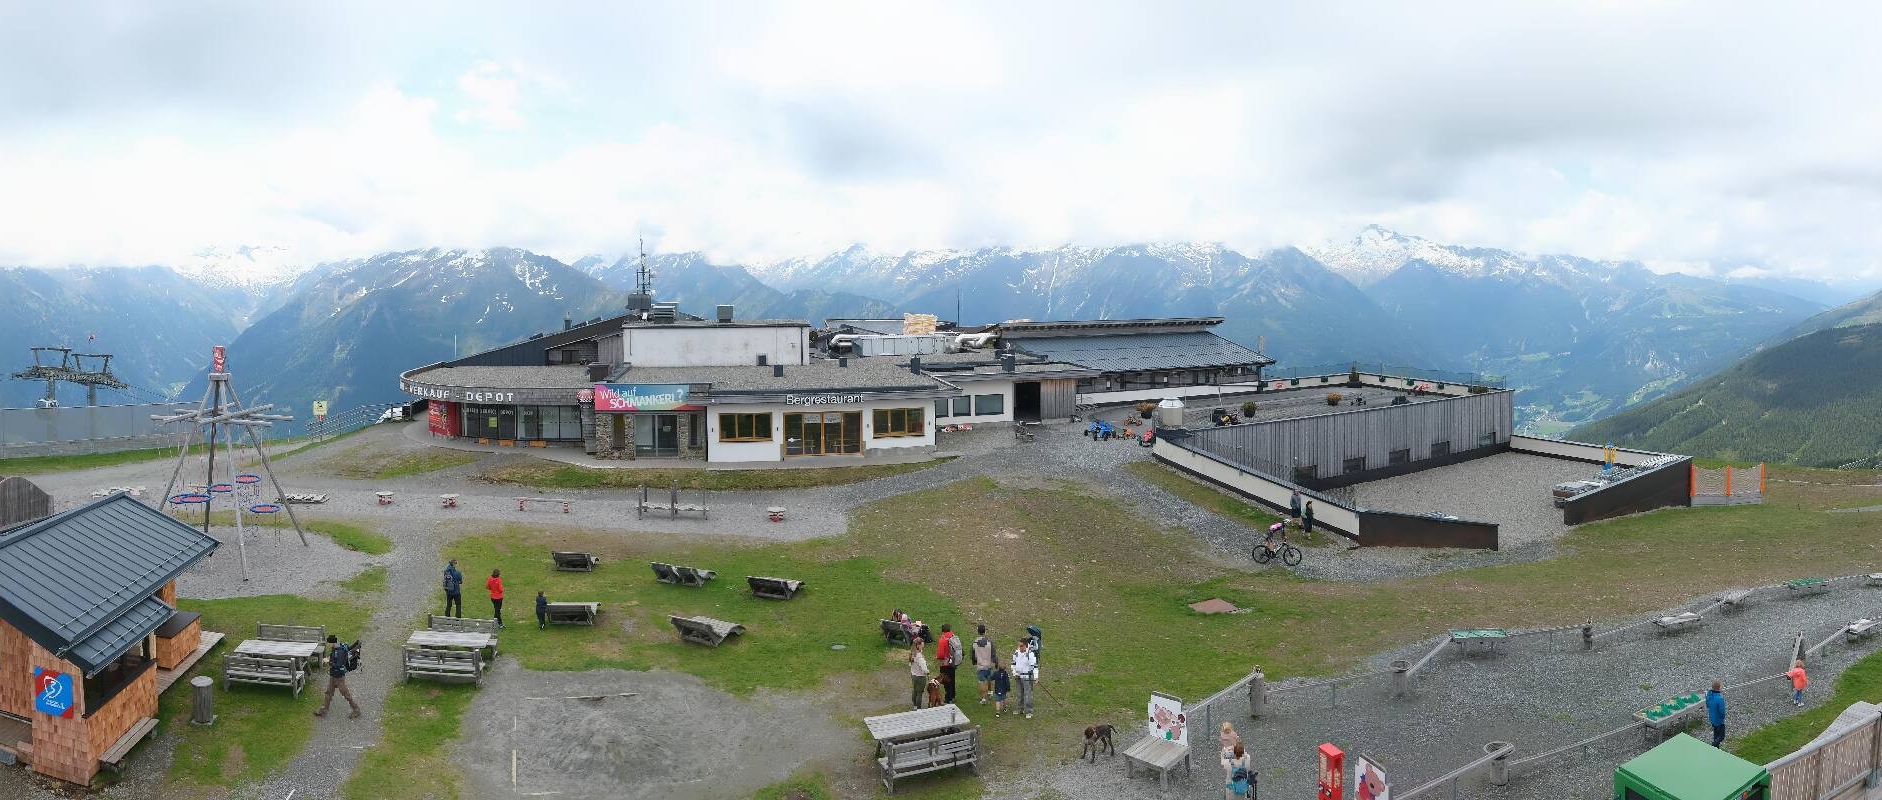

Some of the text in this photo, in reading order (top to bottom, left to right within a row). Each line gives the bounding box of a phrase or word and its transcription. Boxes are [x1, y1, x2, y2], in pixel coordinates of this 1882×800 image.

[409, 385, 450, 399] VERKAUF
[466, 391, 514, 402] DEPOT
[600, 386, 637, 400] Wild auf
[786, 394, 864, 406] Bergrestaurant
